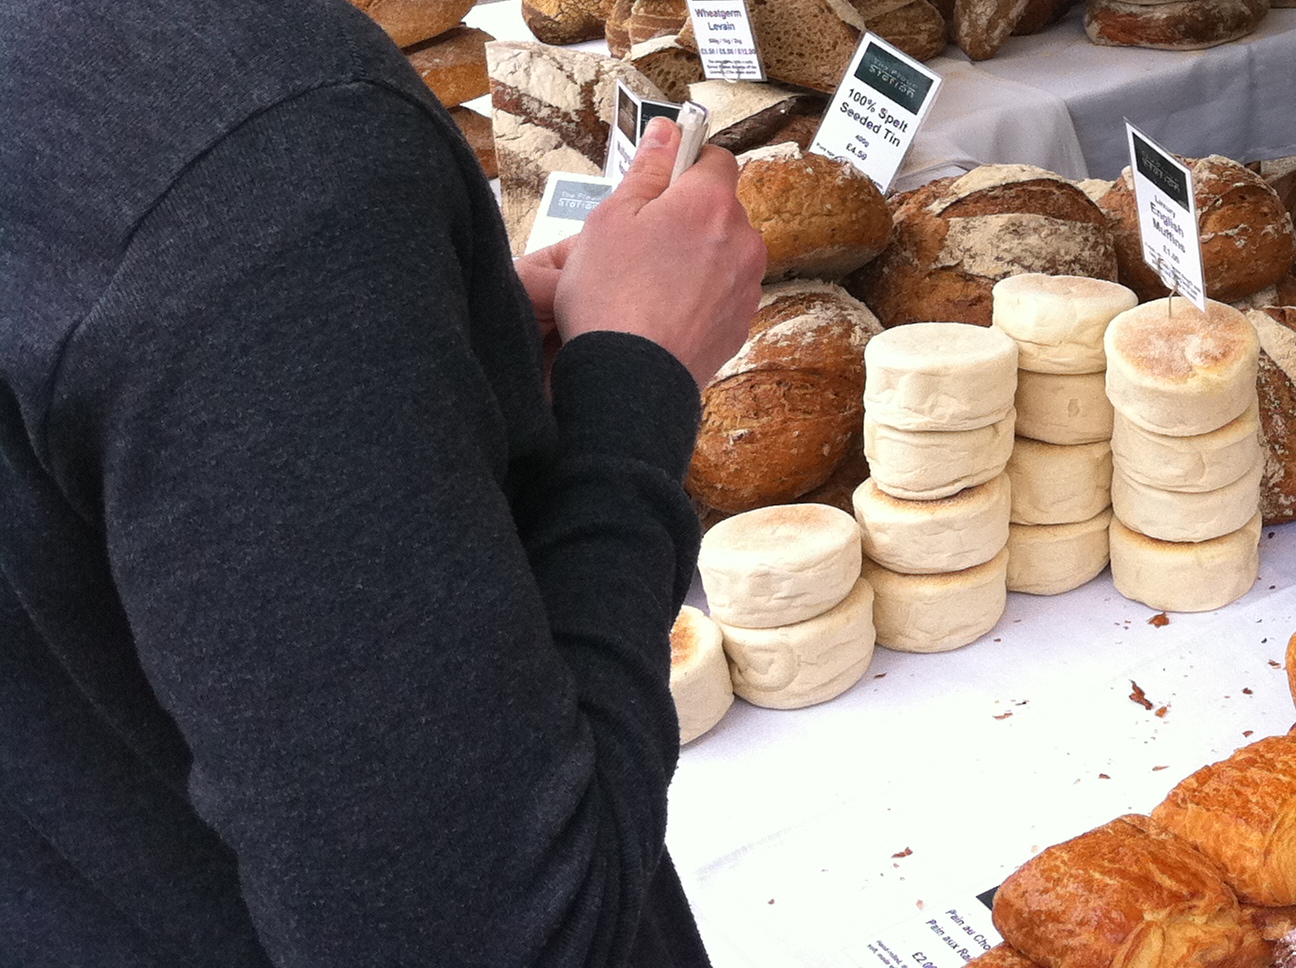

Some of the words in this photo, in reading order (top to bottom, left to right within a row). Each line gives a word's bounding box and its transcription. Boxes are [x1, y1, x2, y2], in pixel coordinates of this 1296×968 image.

[695, 9, 741, 19] Wheatgerm
[707, 21, 735, 30] Levain
[840, 102, 881, 133] Seeded
[883, 128, 901, 147] Tin
[848, 88, 877, 113] 100%
[878, 108, 908, 133] Spelt
[846, 143, 867, 160] £4.50
[1150, 202, 1184, 238] English
[1154, 195, 1176, 218] Luxury
[1152, 218, 1186, 253] Muffins
[926, 919, 945, 936] Pain
[942, 936, 960, 950] aux
[945, 908, 965, 926] Pain
[962, 925, 975, 936] au
